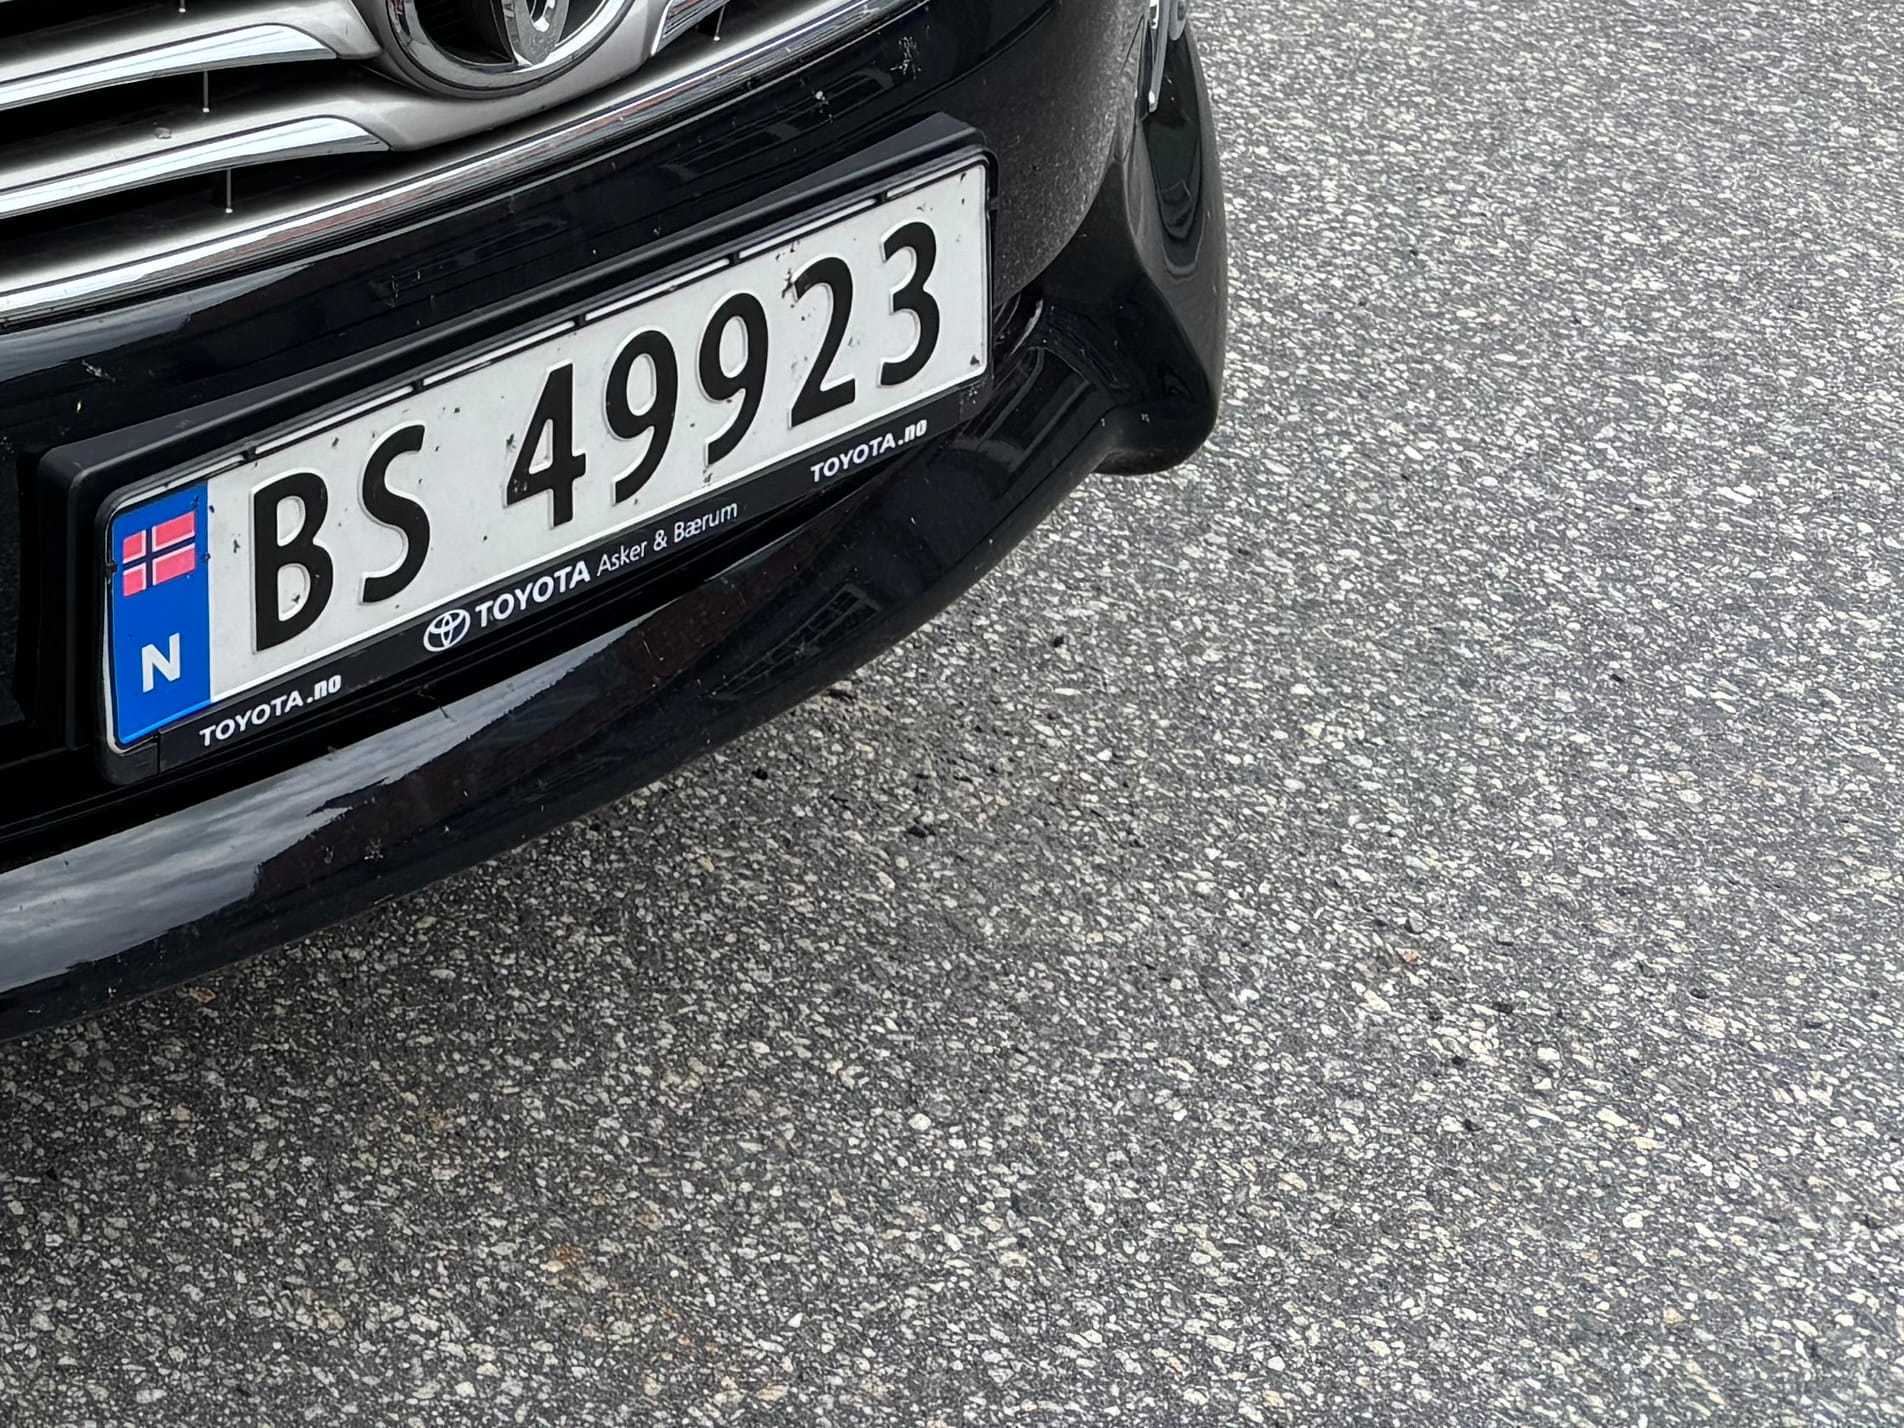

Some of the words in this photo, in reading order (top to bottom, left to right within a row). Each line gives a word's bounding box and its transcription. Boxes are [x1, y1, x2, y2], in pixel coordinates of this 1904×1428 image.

[253, 423, 430, 652] BS
[506, 221, 941, 528] 49923
[475, 560, 591, 628] TOYOTA
[596, 541, 647, 576] Asker
[653, 529, 668, 552] &
[673, 502, 738, 543] Bærum
[142, 632, 180, 693] N
